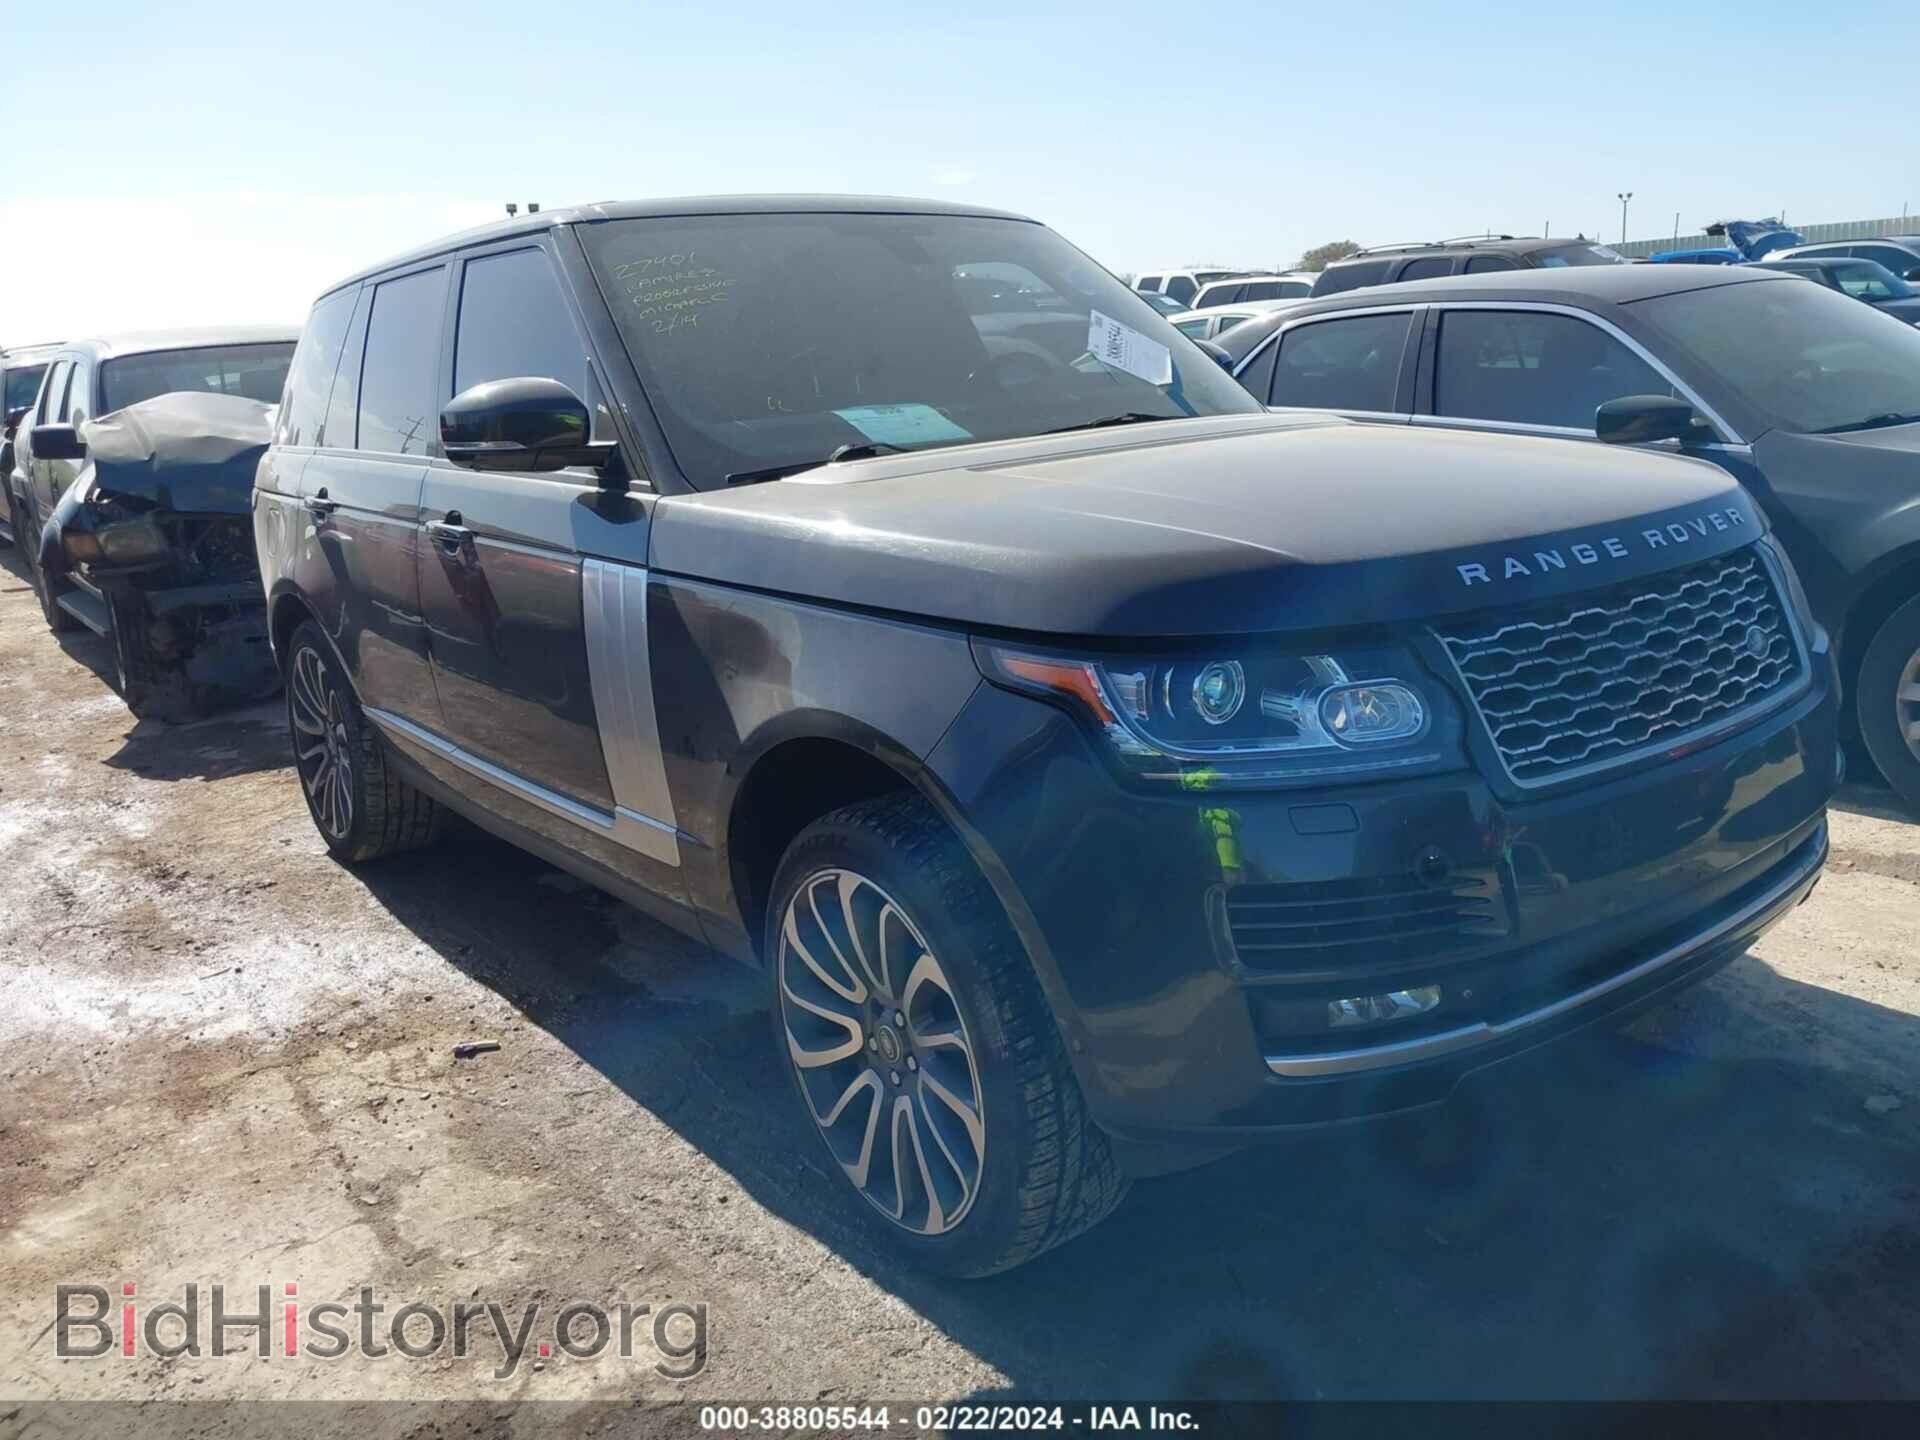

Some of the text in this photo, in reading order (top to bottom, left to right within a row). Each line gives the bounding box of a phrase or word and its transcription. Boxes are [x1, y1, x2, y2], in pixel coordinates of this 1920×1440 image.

[613, 250, 696, 280] 27401
[1456, 508, 1745, 587] RANGE ROVER
